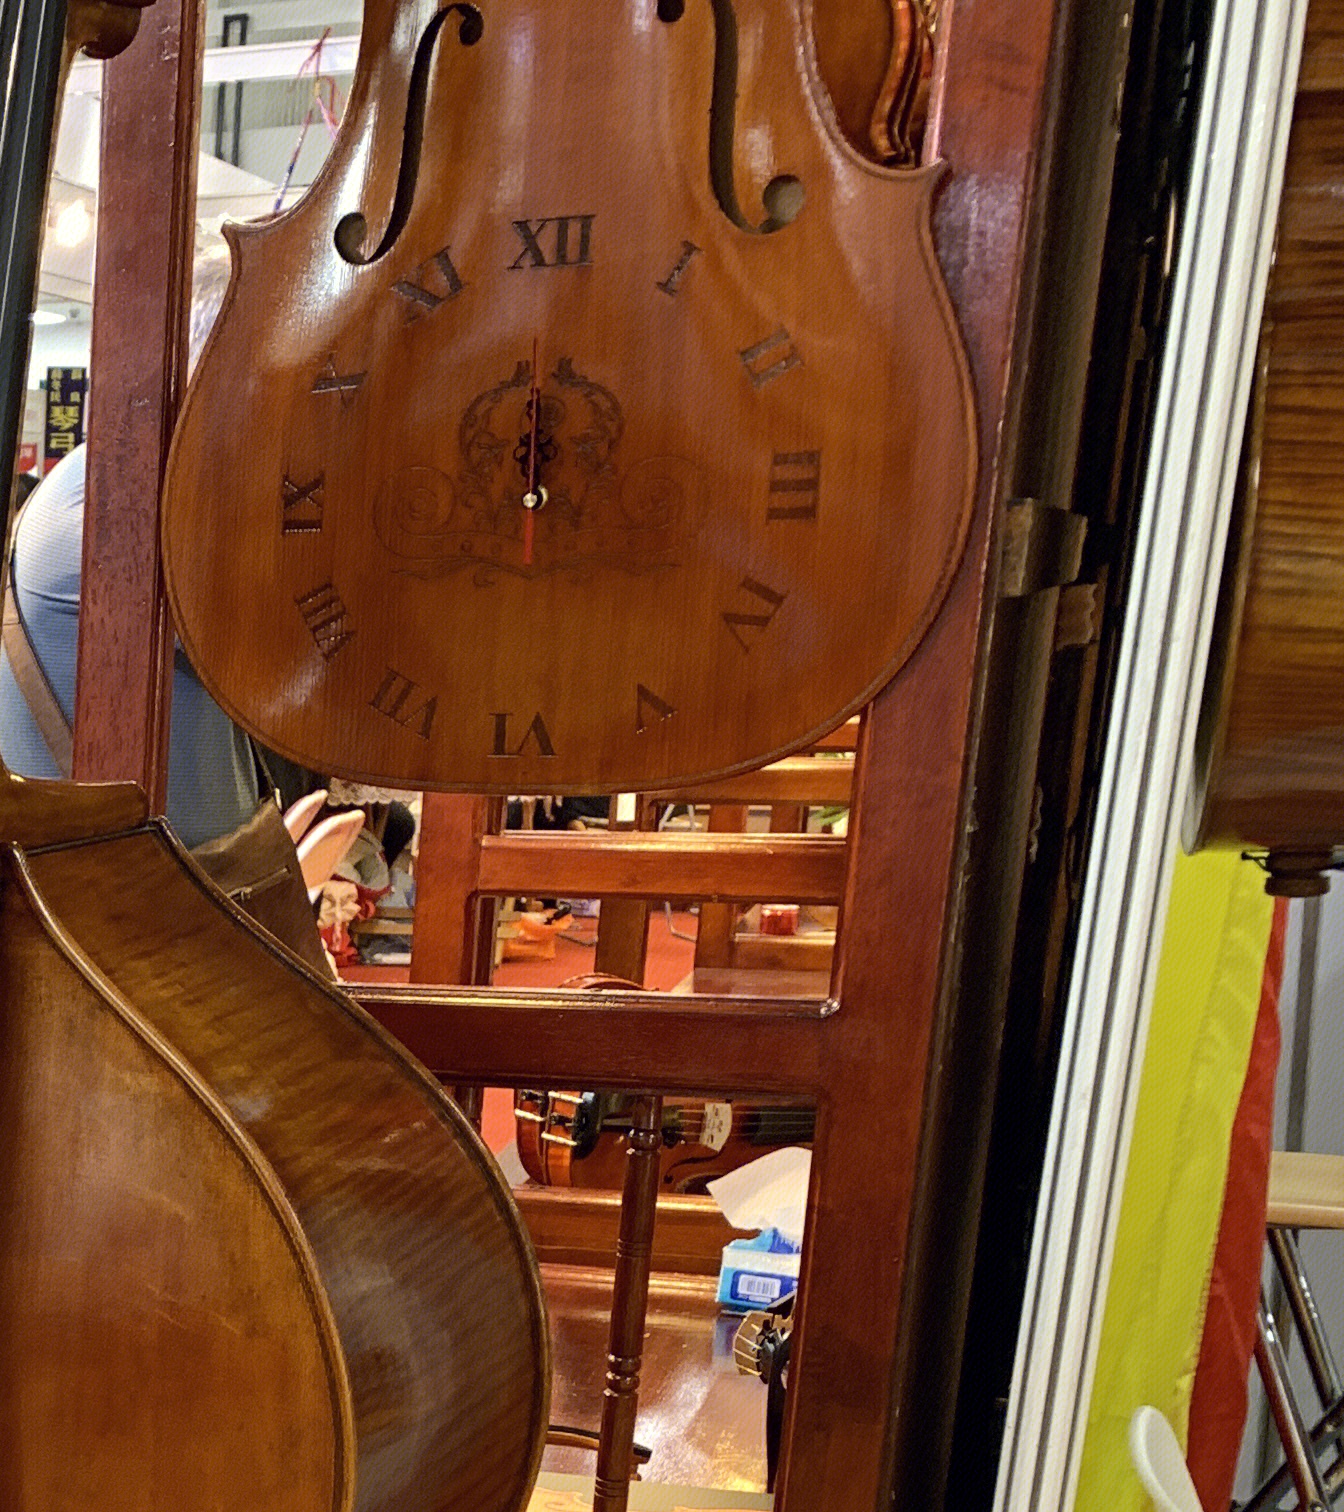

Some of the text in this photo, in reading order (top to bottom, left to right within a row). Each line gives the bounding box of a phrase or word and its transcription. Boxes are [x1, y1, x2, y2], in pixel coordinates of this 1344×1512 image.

[508, 214, 596, 271] XII
[766, 449, 822, 523] III
[486, 712, 558, 758] VI
